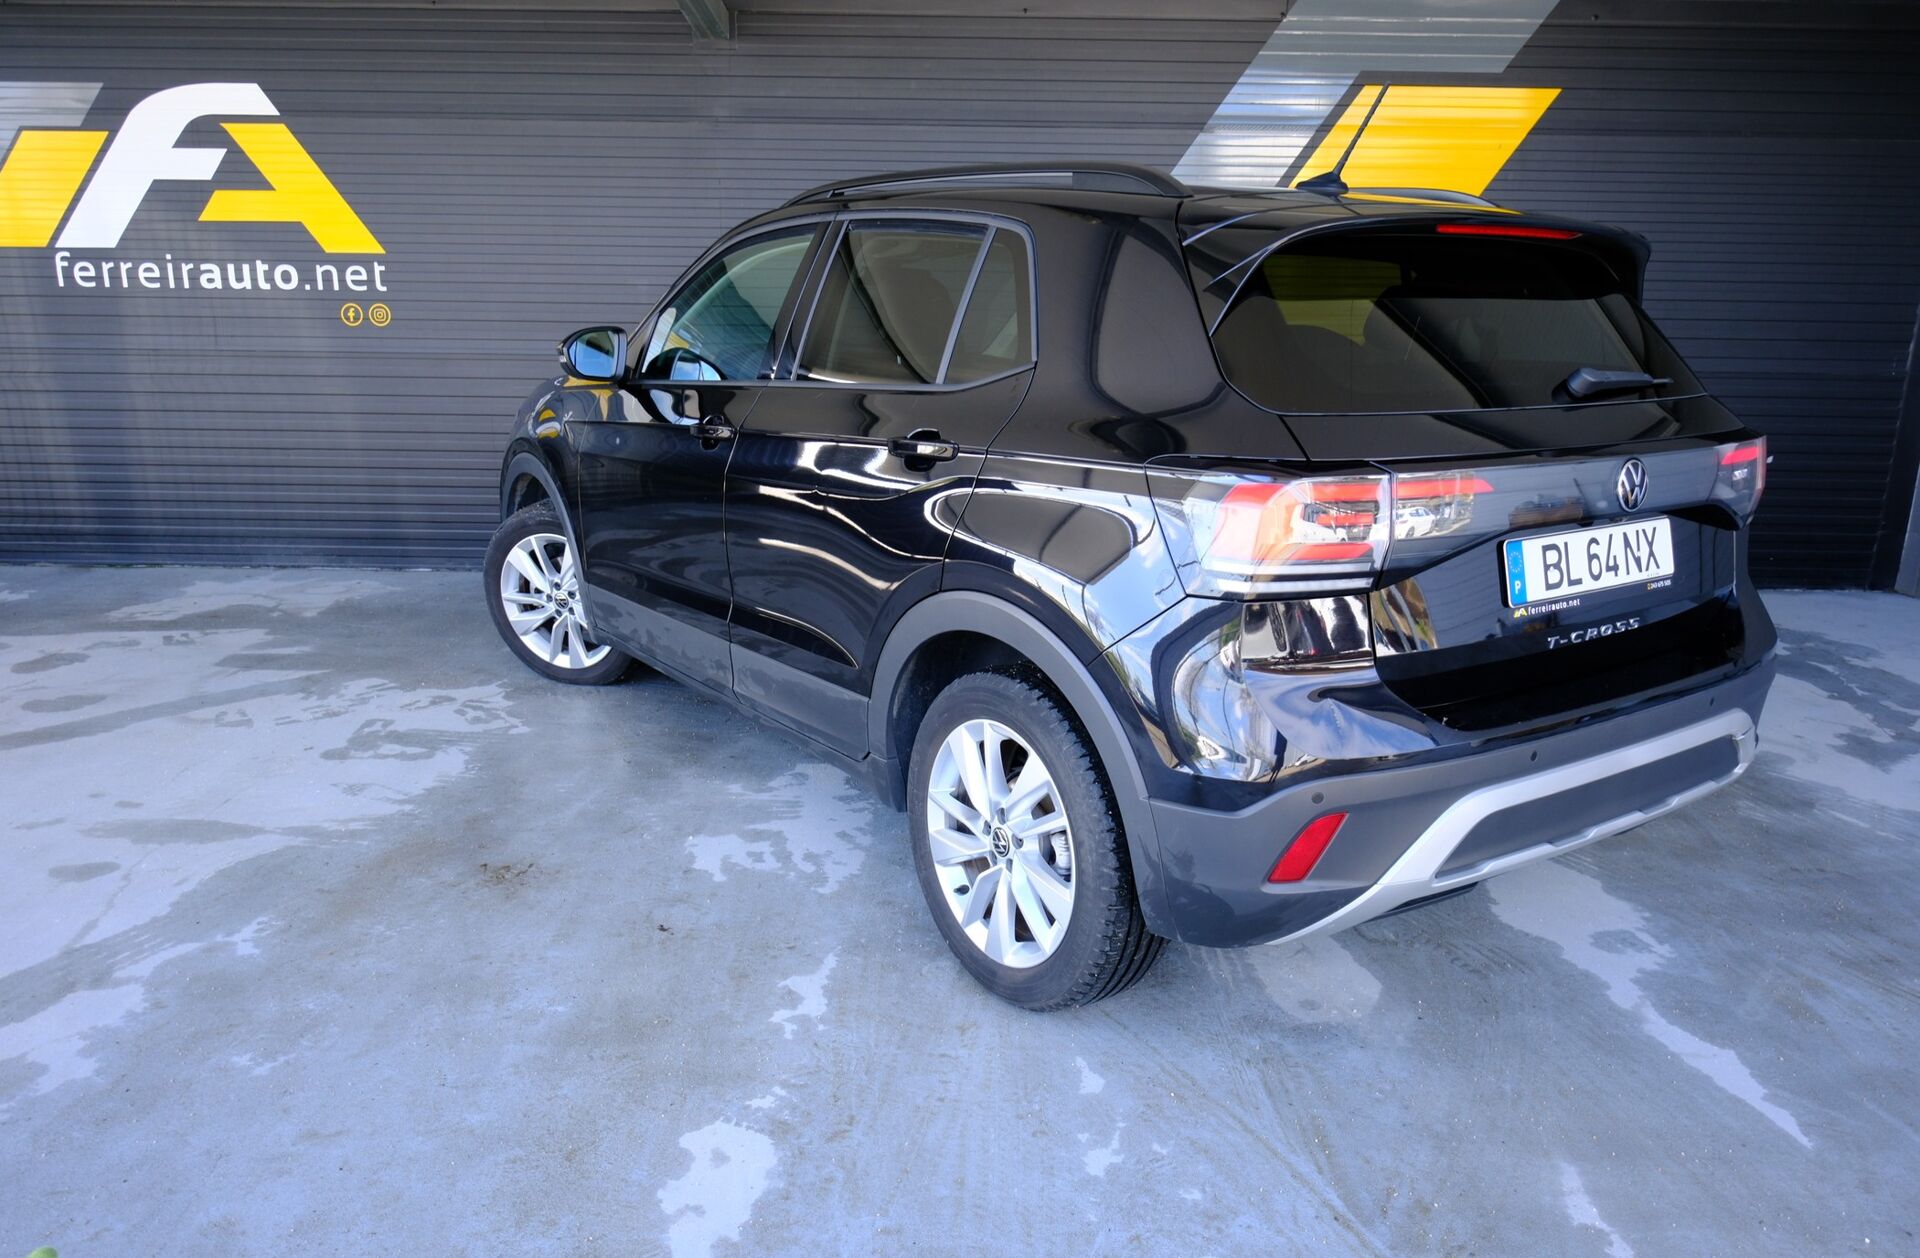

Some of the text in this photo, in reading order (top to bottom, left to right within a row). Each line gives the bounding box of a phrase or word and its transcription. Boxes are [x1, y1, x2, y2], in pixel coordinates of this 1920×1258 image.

[54, 250, 389, 293] ferreirauto.net
[1514, 580, 1522, 595] P
[1528, 599, 1580, 615] ferreirauto.net
[1547, 617, 1640, 649] T-CROSS
